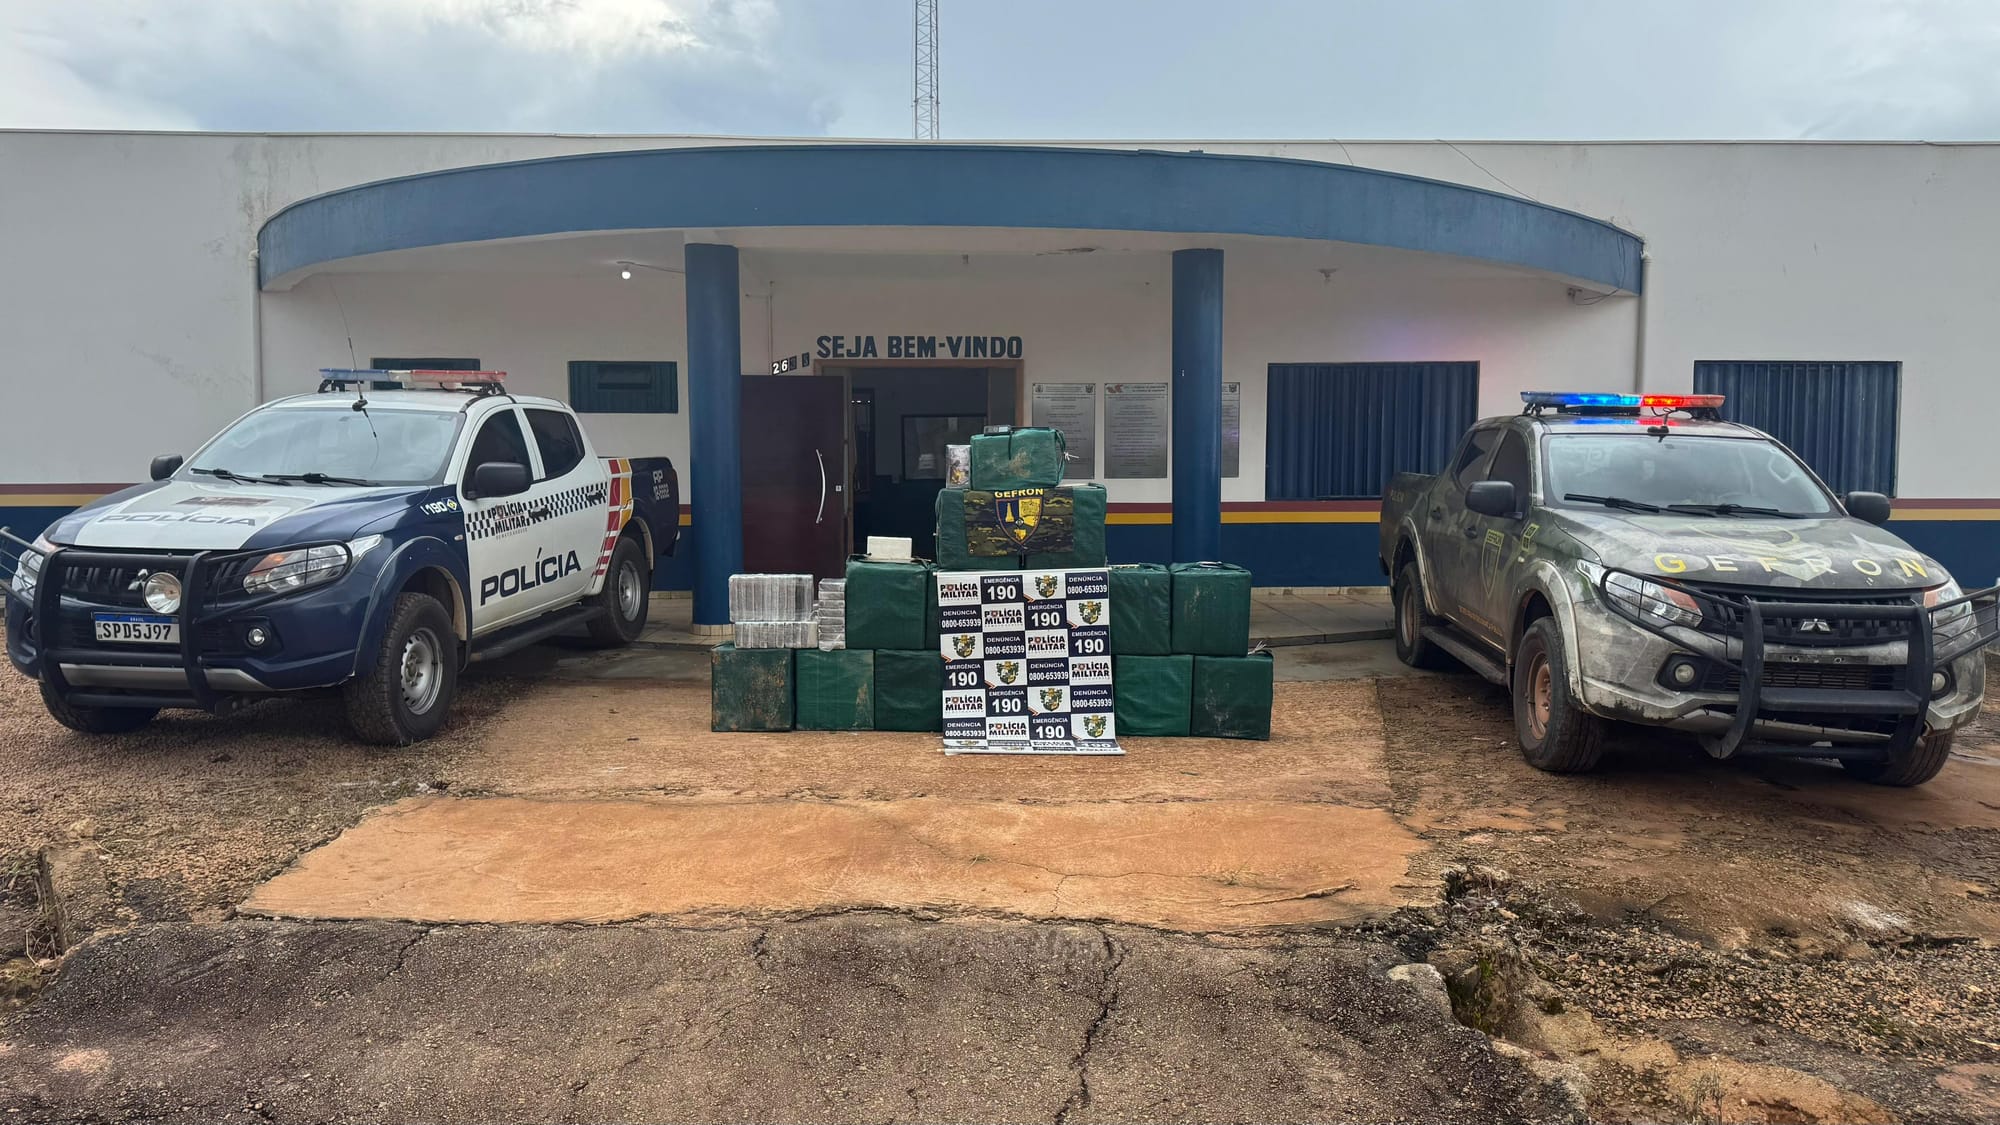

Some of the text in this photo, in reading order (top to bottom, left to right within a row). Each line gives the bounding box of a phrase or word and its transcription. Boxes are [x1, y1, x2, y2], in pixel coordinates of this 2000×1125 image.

[816, 335, 1023, 358] SEJA BEM-VINDO
[994, 488, 1044, 499] GEFRON
[491, 501, 524, 520] POLÍCIA
[97, 512, 256, 527] POLÍCIA
[494, 515, 526, 535] MILITAR
[1654, 552, 1928, 578] GEFRON
[480, 547, 581, 606] POLÍCIA
[1068, 575, 1104, 583] DENÚNCIA
[940, 582, 978, 592] POLÍCIA
[1067, 584, 1108, 595] 0800-653939
[940, 590, 979, 599] MILITAR
[987, 585, 1017, 600] 190
[1027, 603, 1064, 611] EMERGÊNCIA
[943, 609, 977, 617] DENÚNCIA
[984, 608, 1022, 618] POLÍCIA
[941, 618, 982, 629] 0800-653939
[984, 616, 1023, 625] MILITAR
[1031, 612, 1061, 627] 190
[102, 622, 172, 640] SPD5J97
[1071, 629, 1108, 637] EMERGÊNCIA
[986, 635, 1021, 644] DENÚNCIA
[1027, 634, 1066, 644] POLÍCIA
[985, 644, 1026, 655] 0800-653939
[1028, 643, 1066, 651] MILITAR
[1074, 638, 1105, 653] 190
[945, 662, 981, 670] EMERGÊNCIA
[1030, 661, 1065, 669] DENÚNCIA
[1071, 661, 1110, 671] POLÍCIA
[1028, 670, 1069, 681] 0800-653939
[1071, 669, 1110, 678] MILITAR
[948, 671, 978, 687] 190
[988, 688, 1025, 697] EMERGÊNCIA
[1073, 688, 1108, 696] DENÚNCIA
[945, 694, 983, 704] POLÍCIA
[1071, 698, 1112, 708] 0800-653939
[945, 703, 983, 711] MILITAR
[991, 697, 1022, 713] 190
[947, 720, 982, 728] DENÚNCIA
[1032, 716, 1068, 724] EMERGÊNCIA
[988, 721, 1027, 731] POLÍCIA
[945, 729, 986, 738] 0800-653939
[1035, 725, 1065, 739] 190
